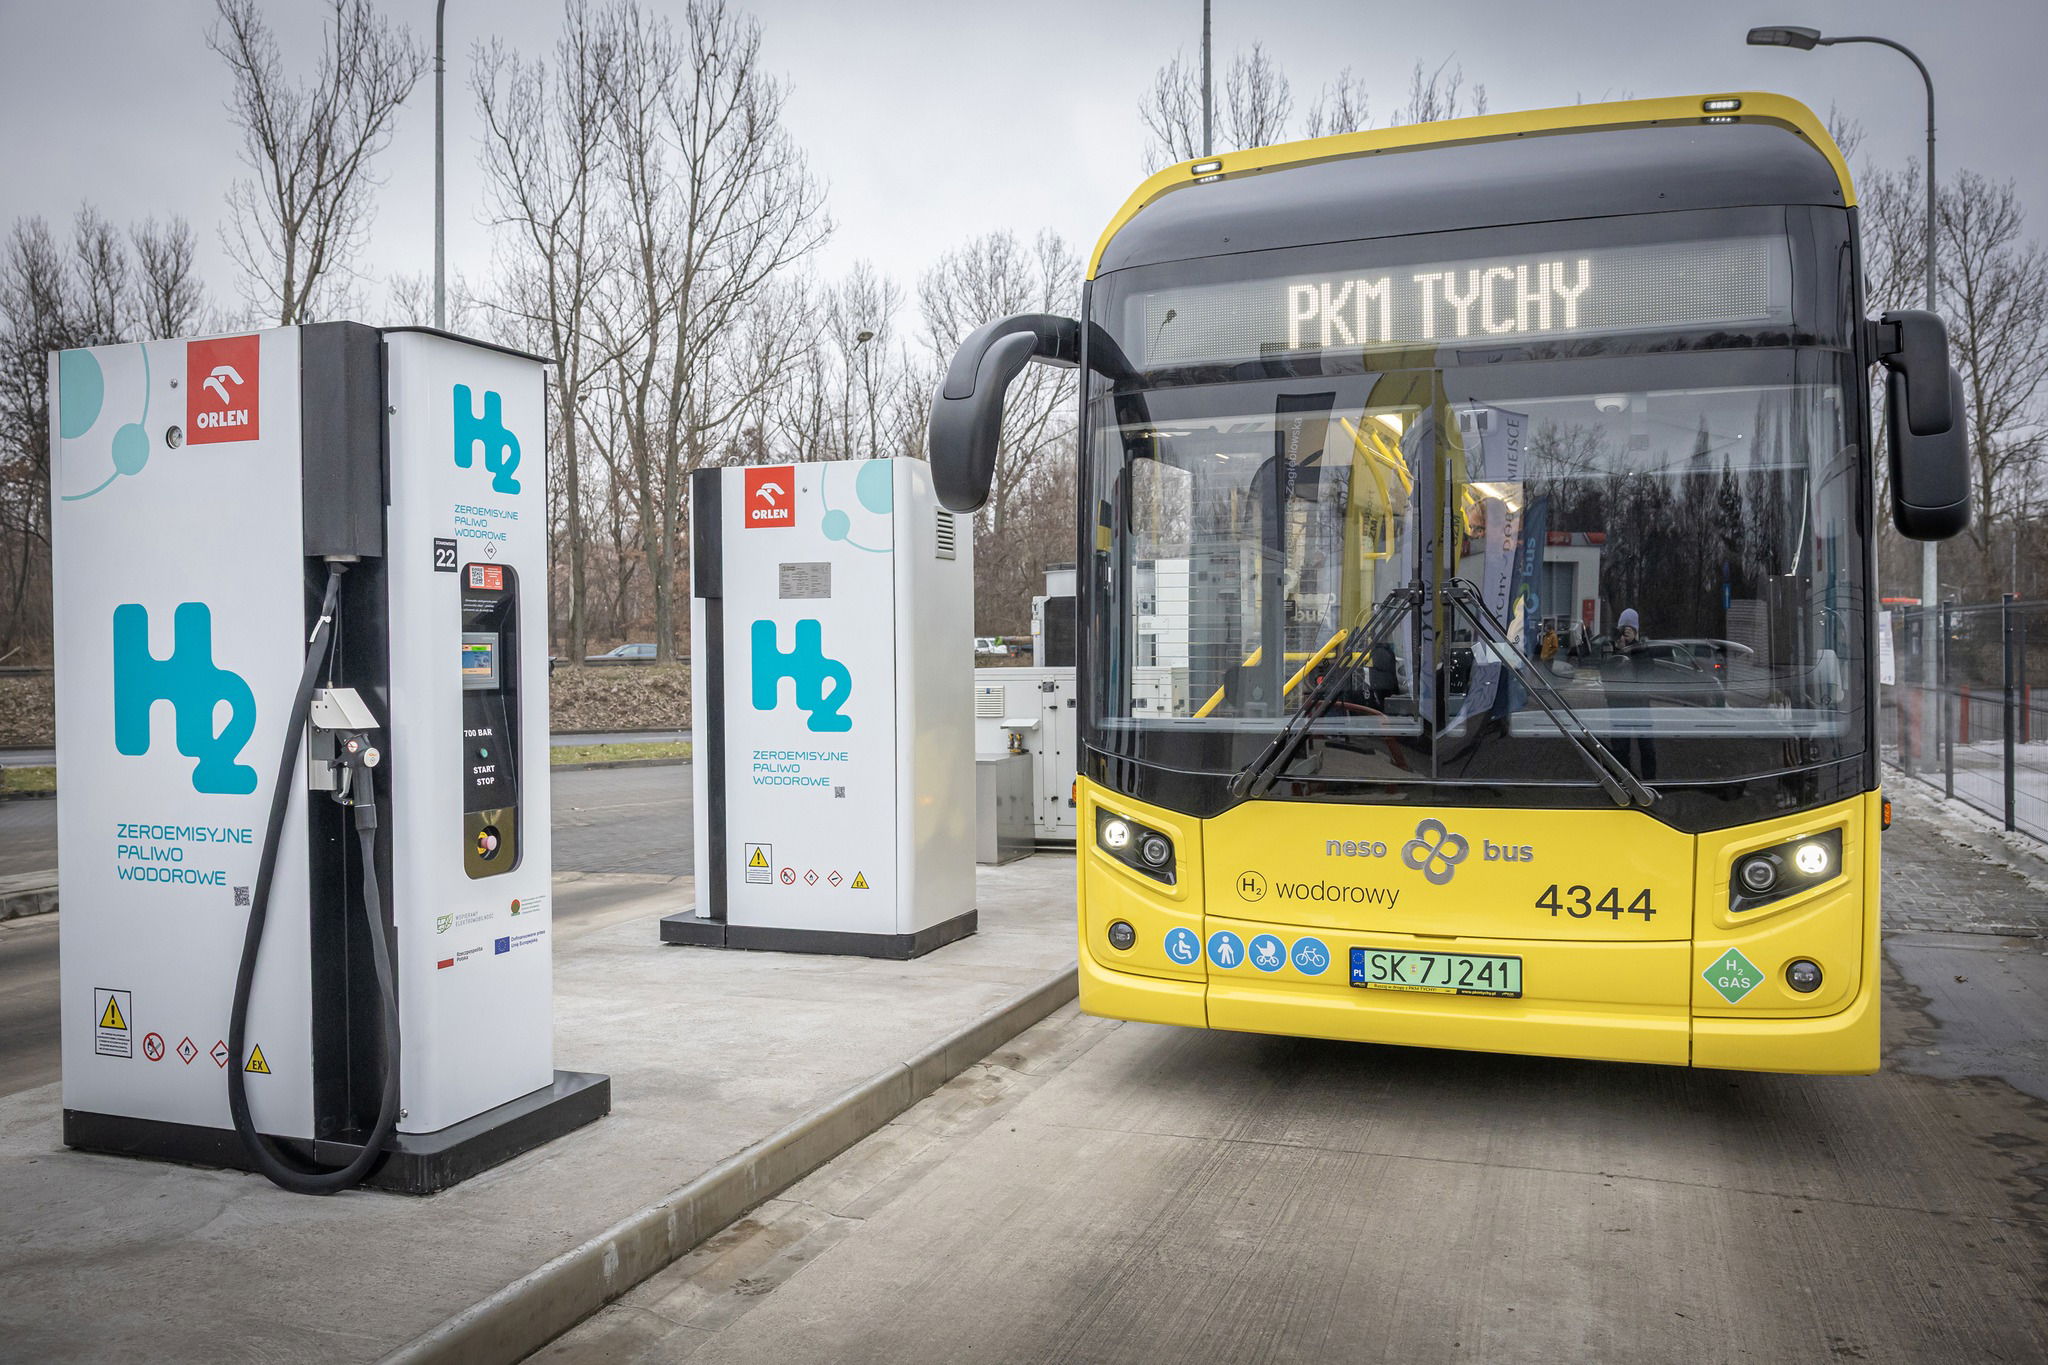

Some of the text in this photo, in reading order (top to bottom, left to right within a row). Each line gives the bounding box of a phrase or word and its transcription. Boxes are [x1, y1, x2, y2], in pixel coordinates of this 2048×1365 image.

[1289, 260, 1589, 349] PKM TYCHY
[197, 409, 248, 429] ORLEN
[453, 383, 521, 495] H2
[454, 504, 519, 520] ZEROEMISYJNE
[752, 508, 788, 520] ORLEN
[454, 516, 488, 527] PALIWO
[454, 527, 507, 541] WODOROWE
[436, 548, 456, 568] 22
[751, 619, 853, 732] H2
[113, 602, 258, 795] H2
[464, 728, 493, 737] 700 BAR
[753, 751, 848, 761] ZEROEMISYJNE
[473, 765, 495, 774] START
[753, 763, 801, 773] PALIWO
[477, 777, 495, 785] STOP
[753, 776, 830, 786] WODOROWE
[117, 823, 253, 844] ZEROEMISYJNE
[117, 844, 183, 862] PALIWO
[1326, 838, 1534, 862] neso bus
[117, 865, 226, 886] WODOROWE
[1276, 880, 1400, 909] wodorowy
[1535, 884, 1657, 921] 4344
[1353, 954, 1508, 988] PL SK 7J241
[1718, 976, 1750, 989] GAS
[252, 1059, 263, 1070] EX
